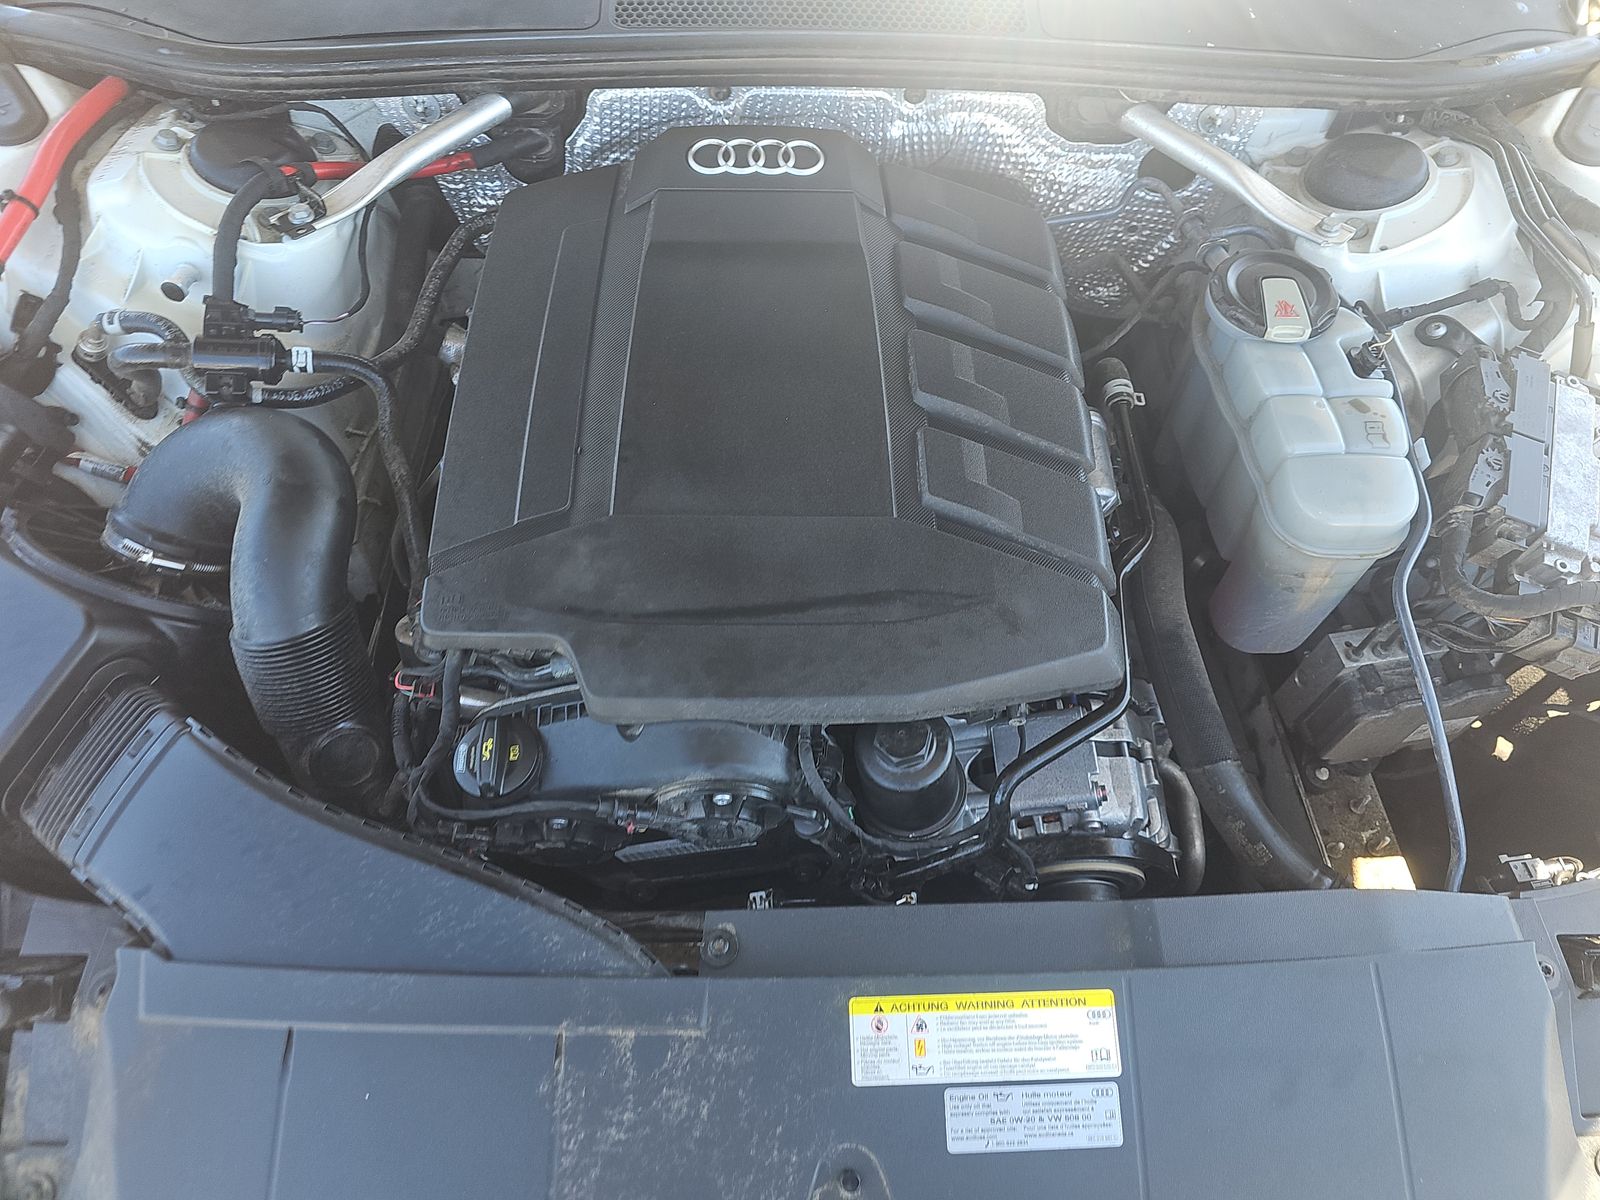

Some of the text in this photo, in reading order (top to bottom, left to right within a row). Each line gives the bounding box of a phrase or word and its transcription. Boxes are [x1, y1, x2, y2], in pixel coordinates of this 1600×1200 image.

[890, 997, 1087, 1013] ACHTUNG WARNING ATTENTION
[950, 1092, 988, 1102] Engine Oil
[1043, 1090, 1072, 1098] moteur
[1047, 1114, 1062, 1122] VW
